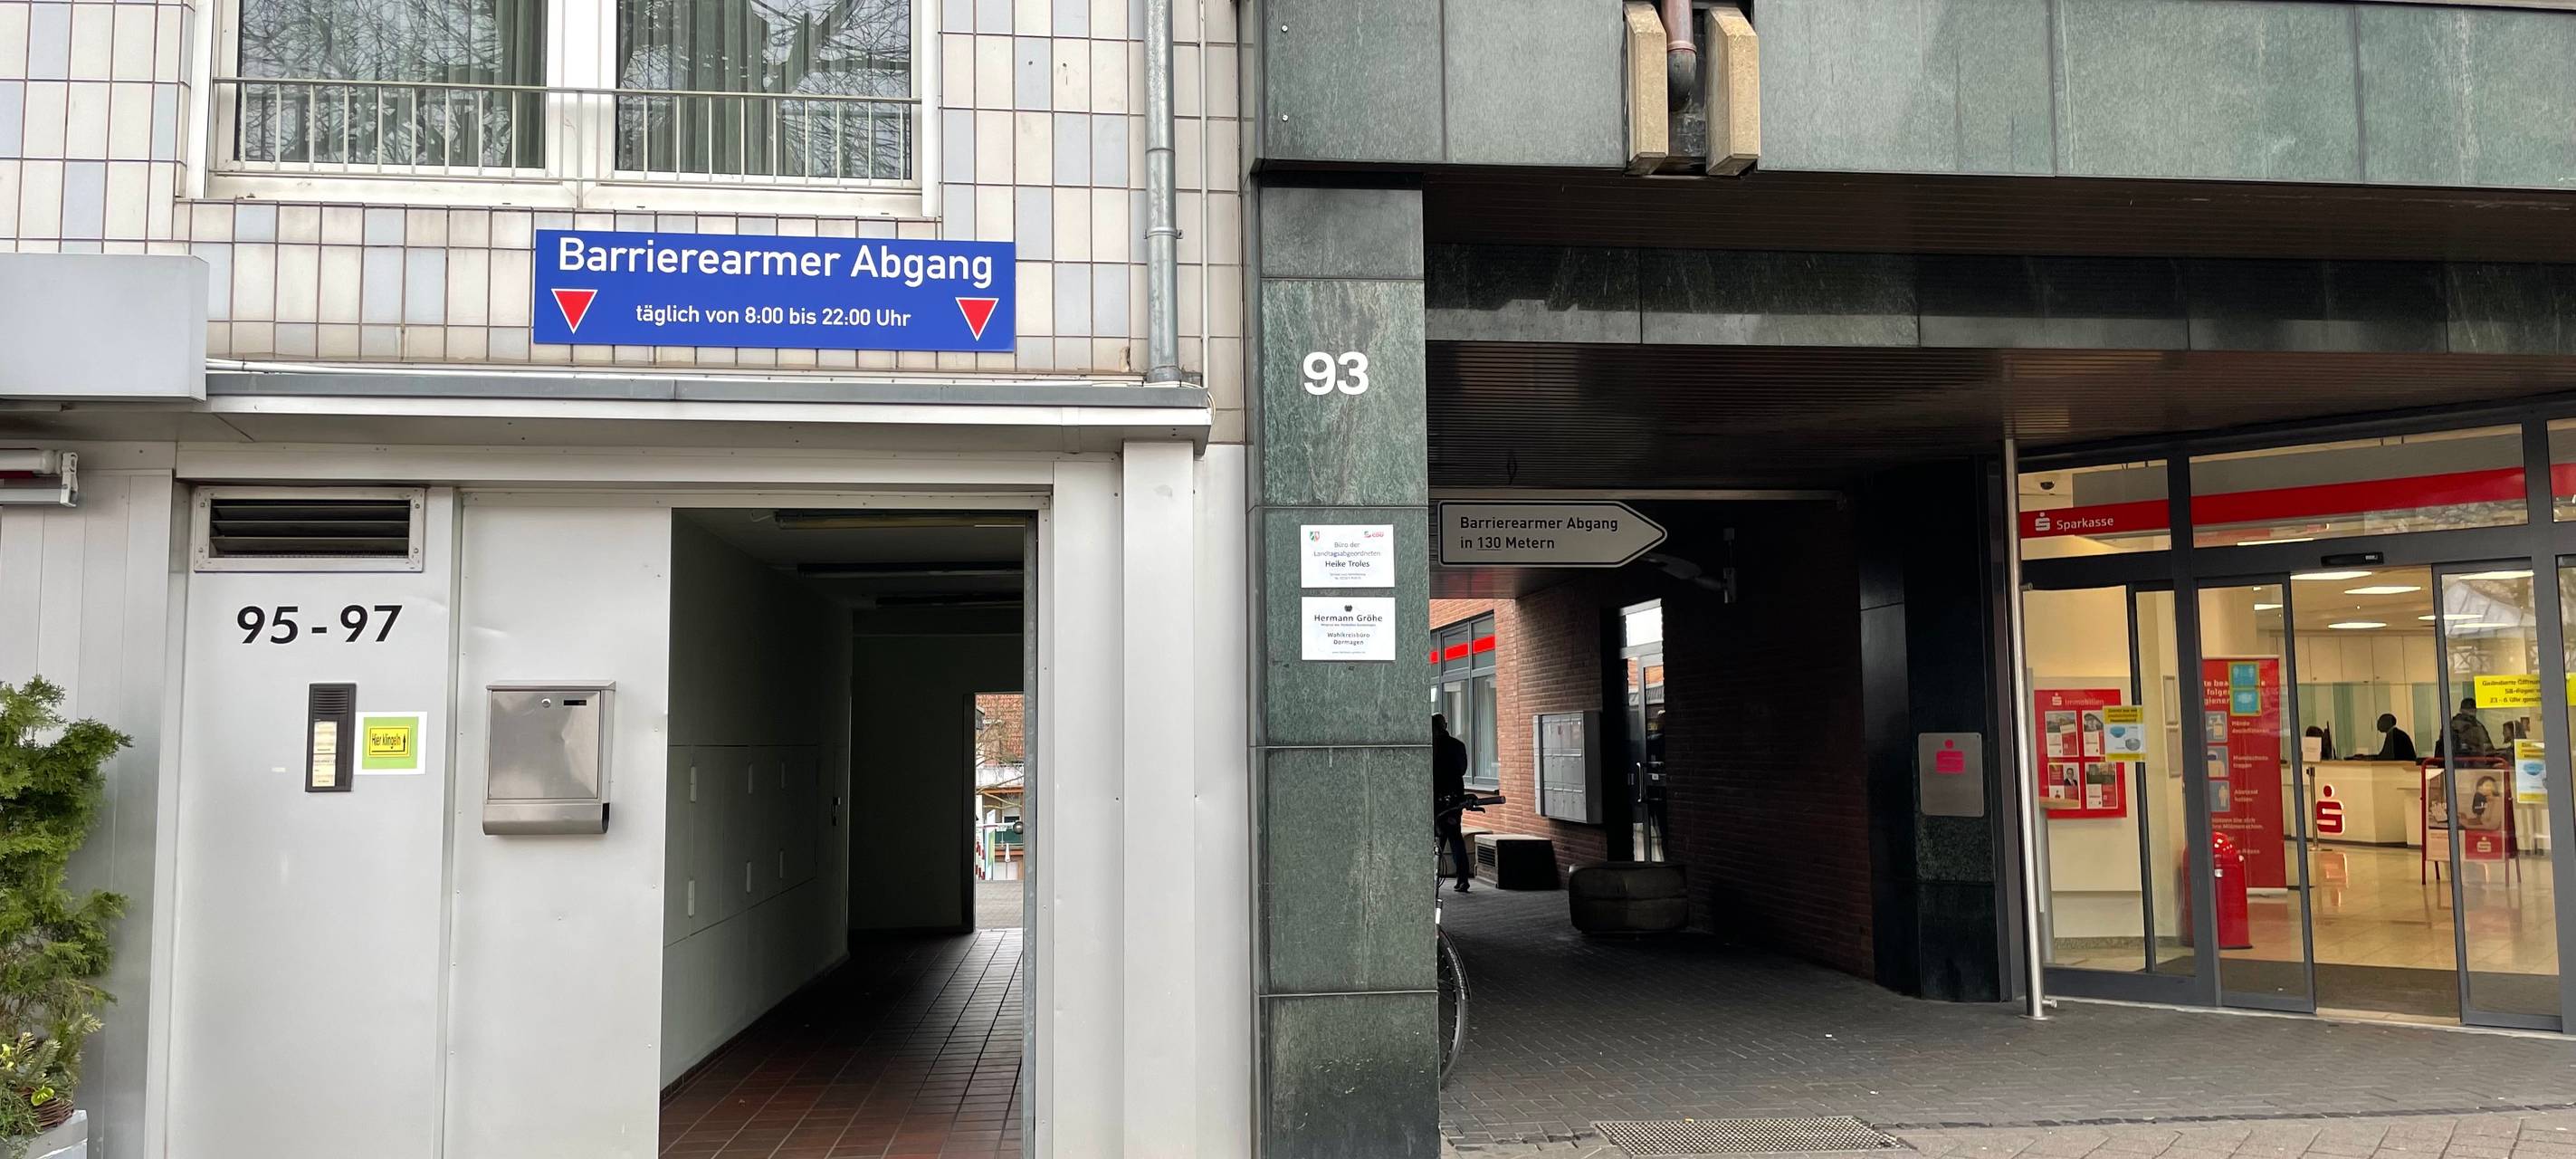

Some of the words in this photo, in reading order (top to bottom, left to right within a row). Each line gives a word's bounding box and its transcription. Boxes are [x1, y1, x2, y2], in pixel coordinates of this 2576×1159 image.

[558, 236, 841, 277] Barrierearmer
[850, 244, 993, 289] Abgang
[635, 304, 700, 327] täglich
[705, 310, 739, 324] von
[745, 306, 784, 325] 8:00
[789, 306, 816, 326] bis
[822, 308, 871, 327] 22:00
[876, 309, 911, 328] Uhr
[1302, 351, 1369, 396] 93
[1460, 516, 1563, 530] Barrierearmer
[1567, 516, 1618, 532] Abgang
[2056, 517, 2114, 532] Sparkasse
[1460, 537, 1473, 549] in
[1477, 536, 1502, 551] 130
[1505, 537, 1555, 550] Metern
[237, 606, 299, 645] 95
[339, 605, 404, 643] 97
[1314, 614, 1354, 622] Hermann
[1357, 614, 1383, 622] Gröhe
[372, 733, 381, 746] Hier
[382, 733, 402, 749] klingeln
